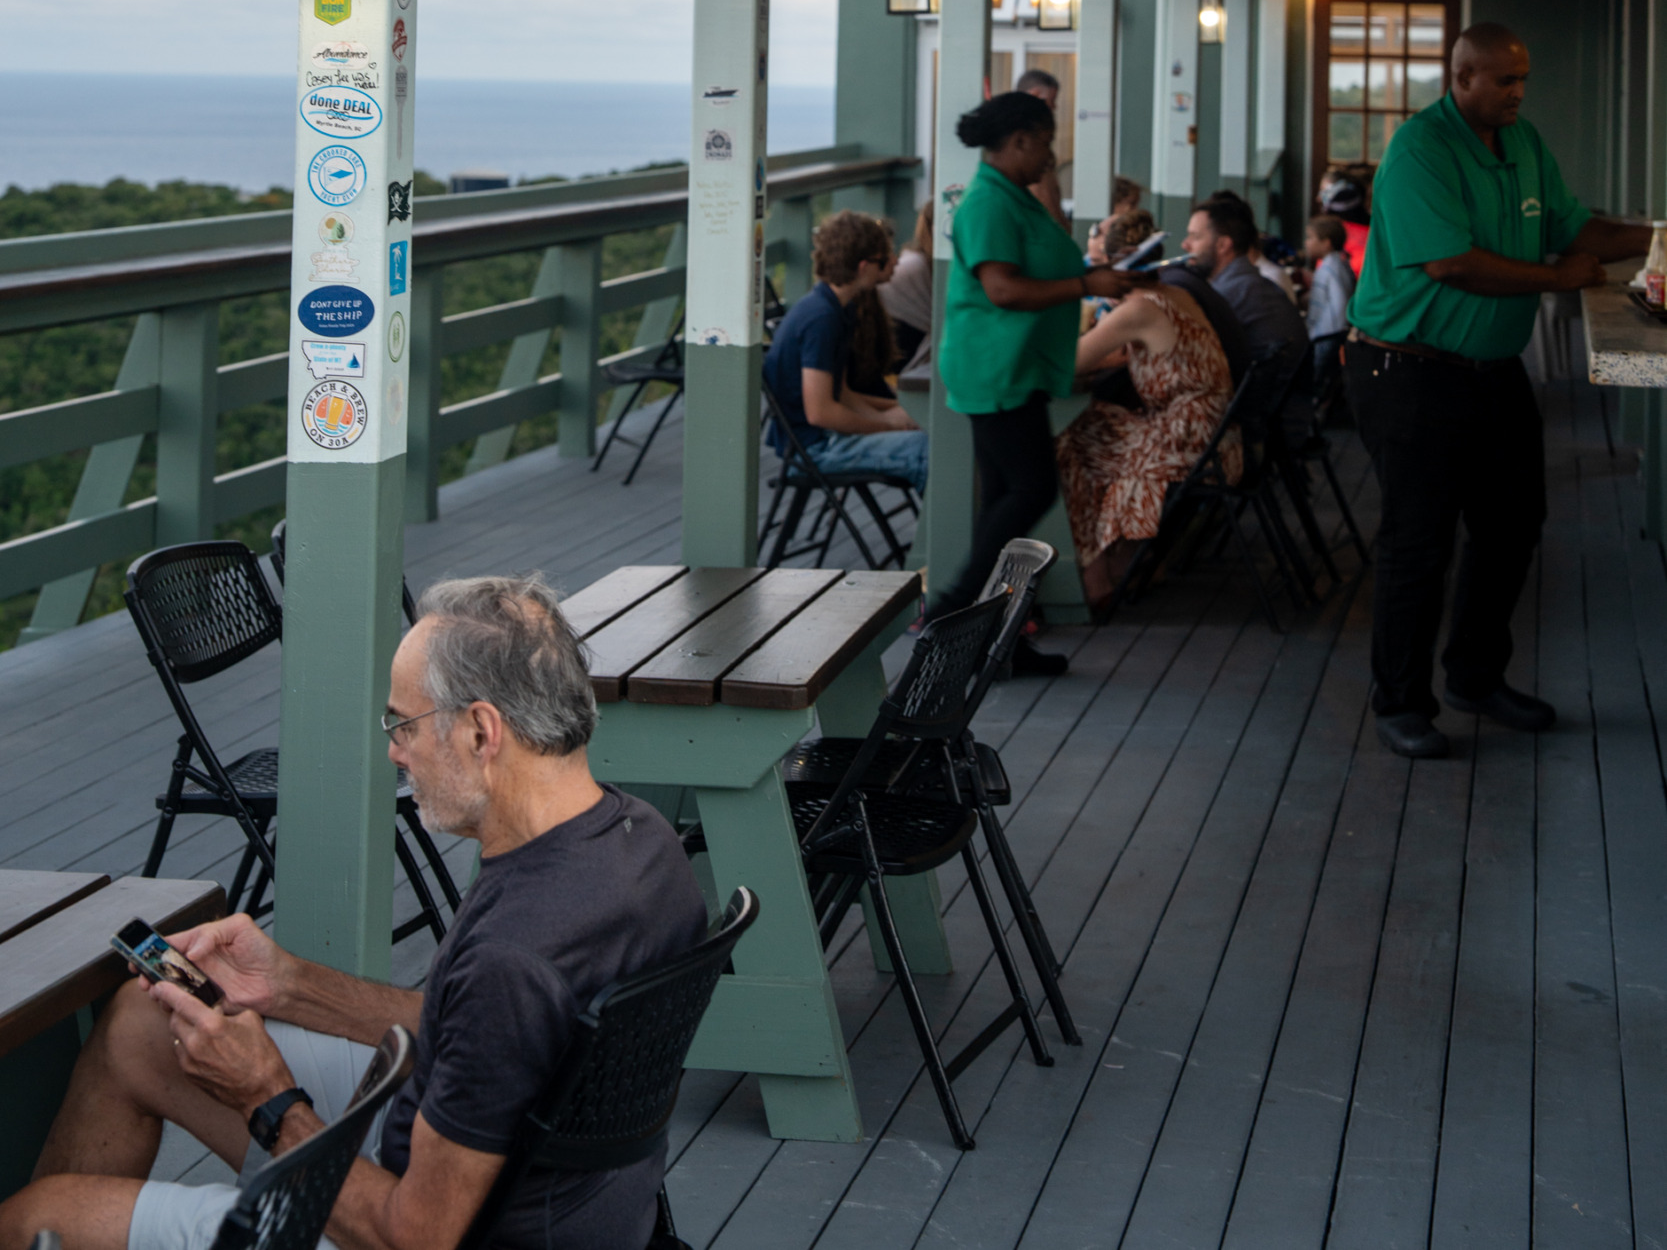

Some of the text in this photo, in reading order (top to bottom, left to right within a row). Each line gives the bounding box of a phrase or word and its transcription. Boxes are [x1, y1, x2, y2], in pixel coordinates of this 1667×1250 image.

[321, 4, 345, 13] FIRE
[309, 93, 372, 115] done DEAL
[332, 300, 352, 308] GIVE
[353, 300, 362, 308] UP
[315, 310, 363, 321] THE SHIP
[305, 383, 365, 426] BEACH & BREW
[310, 428, 349, 447] ON 30A
